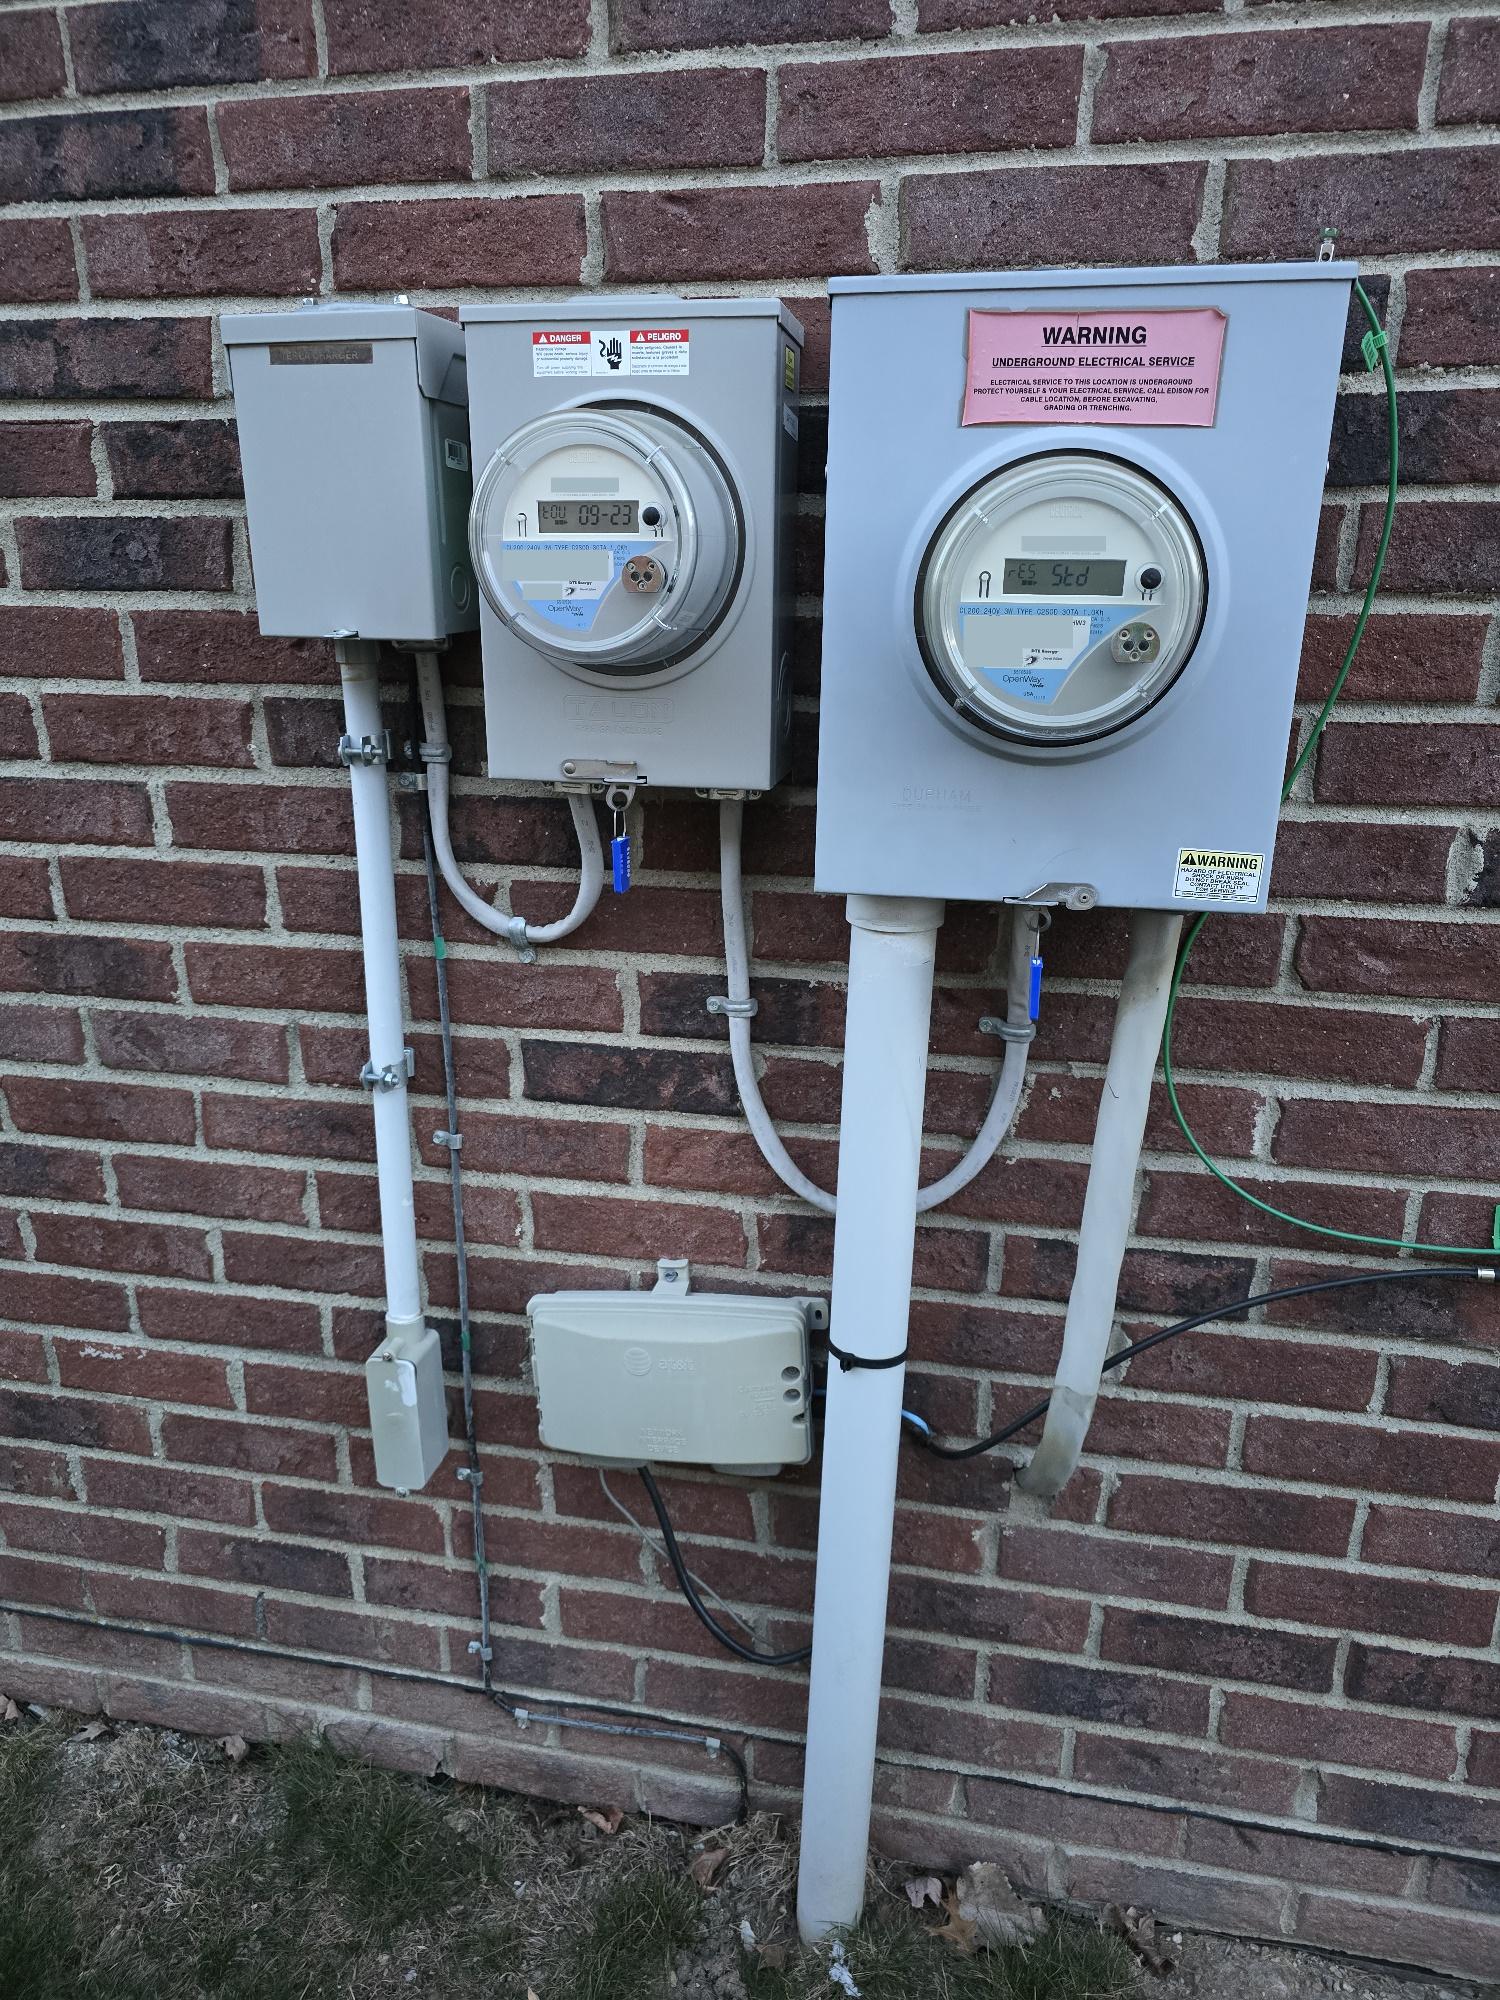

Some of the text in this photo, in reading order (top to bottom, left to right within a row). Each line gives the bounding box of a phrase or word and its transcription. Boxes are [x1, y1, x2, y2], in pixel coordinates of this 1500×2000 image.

[549, 334, 582, 343] DANGER
[647, 332, 682, 341] PELIGRO
[1042, 325, 1147, 345] WARNING
[313, 350, 359, 361] CHARGER
[992, 356, 1196, 367] UNDERGROUND ELECTRICAL SERVICE
[1033, 378, 1062, 386] SERVICE
[1138, 378, 1193, 386] UNDERGROUND
[1112, 396, 1158, 404] EXCAVATING,
[578, 504, 632, 526] 09-23
[547, 604, 582, 613] OpenWay
[1002, 674, 1042, 684] OpenWay
[567, 700, 672, 719] TALON
[903, 784, 972, 803] DURHAM
[1197, 854, 1258, 870] WARNING
